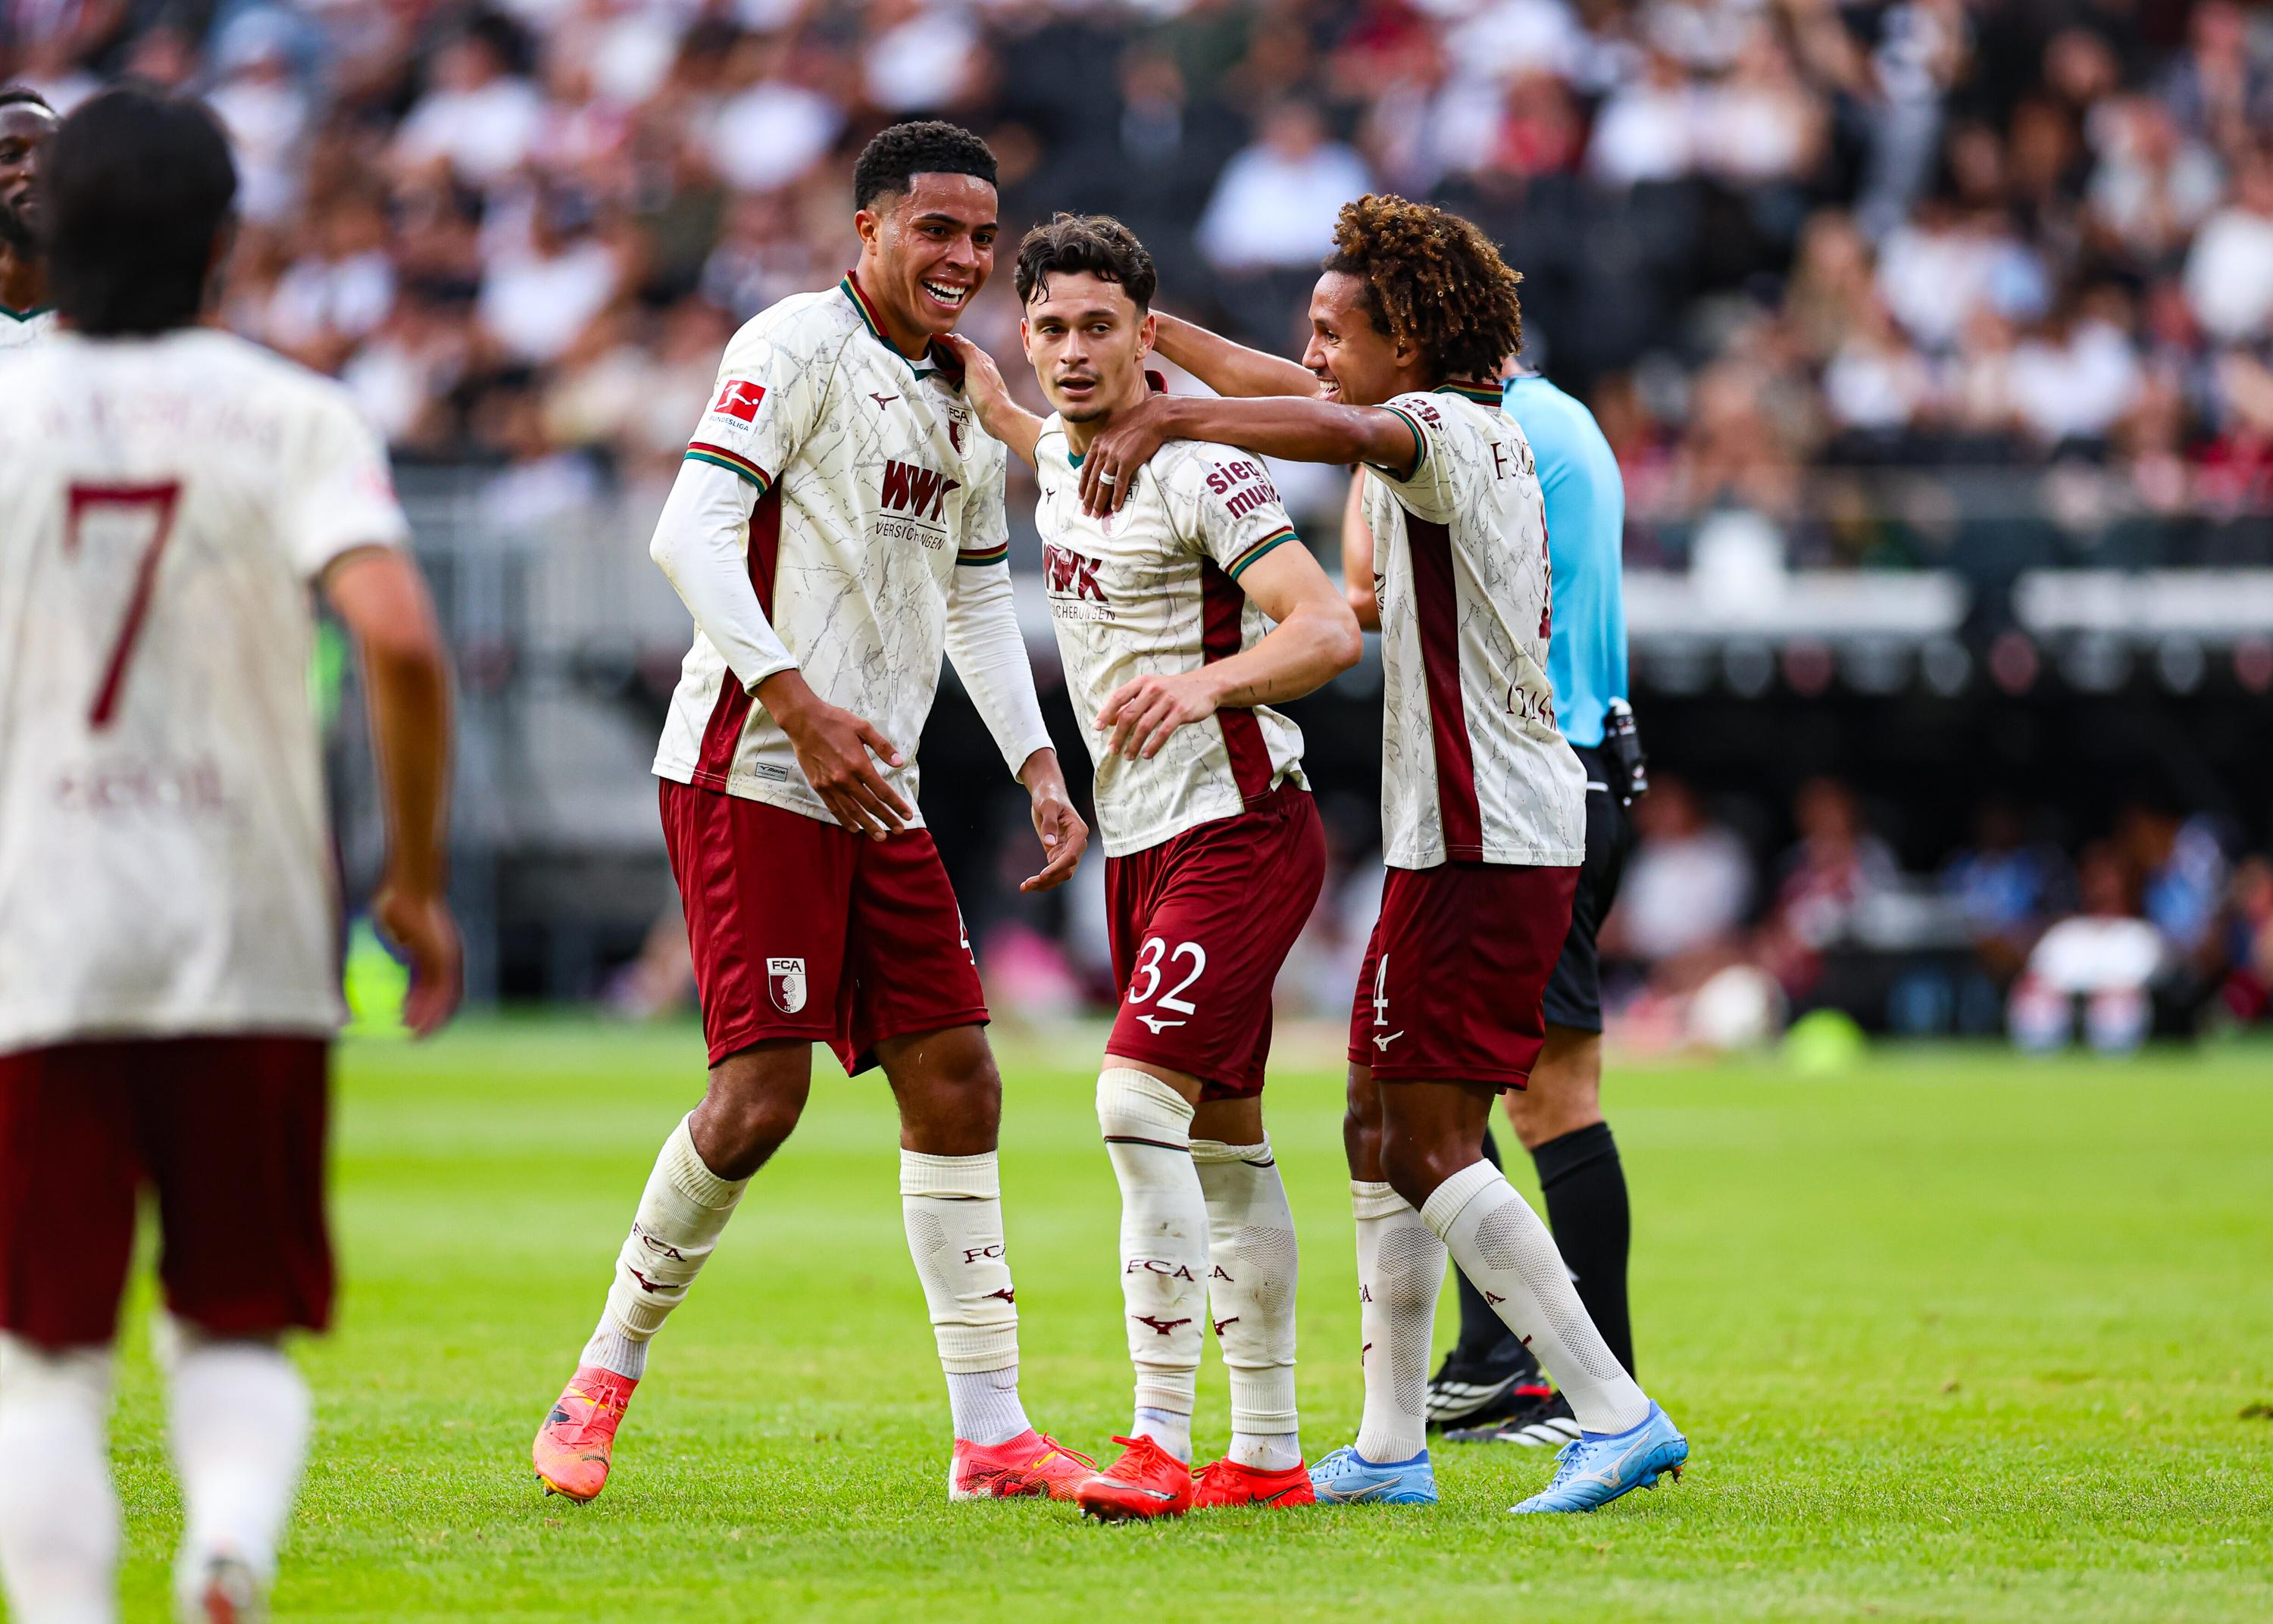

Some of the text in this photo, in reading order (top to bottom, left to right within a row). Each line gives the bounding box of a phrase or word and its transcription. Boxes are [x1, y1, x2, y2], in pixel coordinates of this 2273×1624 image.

[709, 416, 749, 432] BUNDESLIGA
[949, 408, 970, 424] FCA
[881, 459, 961, 525] WWK
[63, 479, 184, 729] 7
[772, 960, 802, 973] FCA
[1127, 937, 1207, 1015] 32
[1373, 953, 1388, 1026] 4
[633, 1222, 687, 1262] FCA
[1127, 1260, 1195, 1282] FCA
